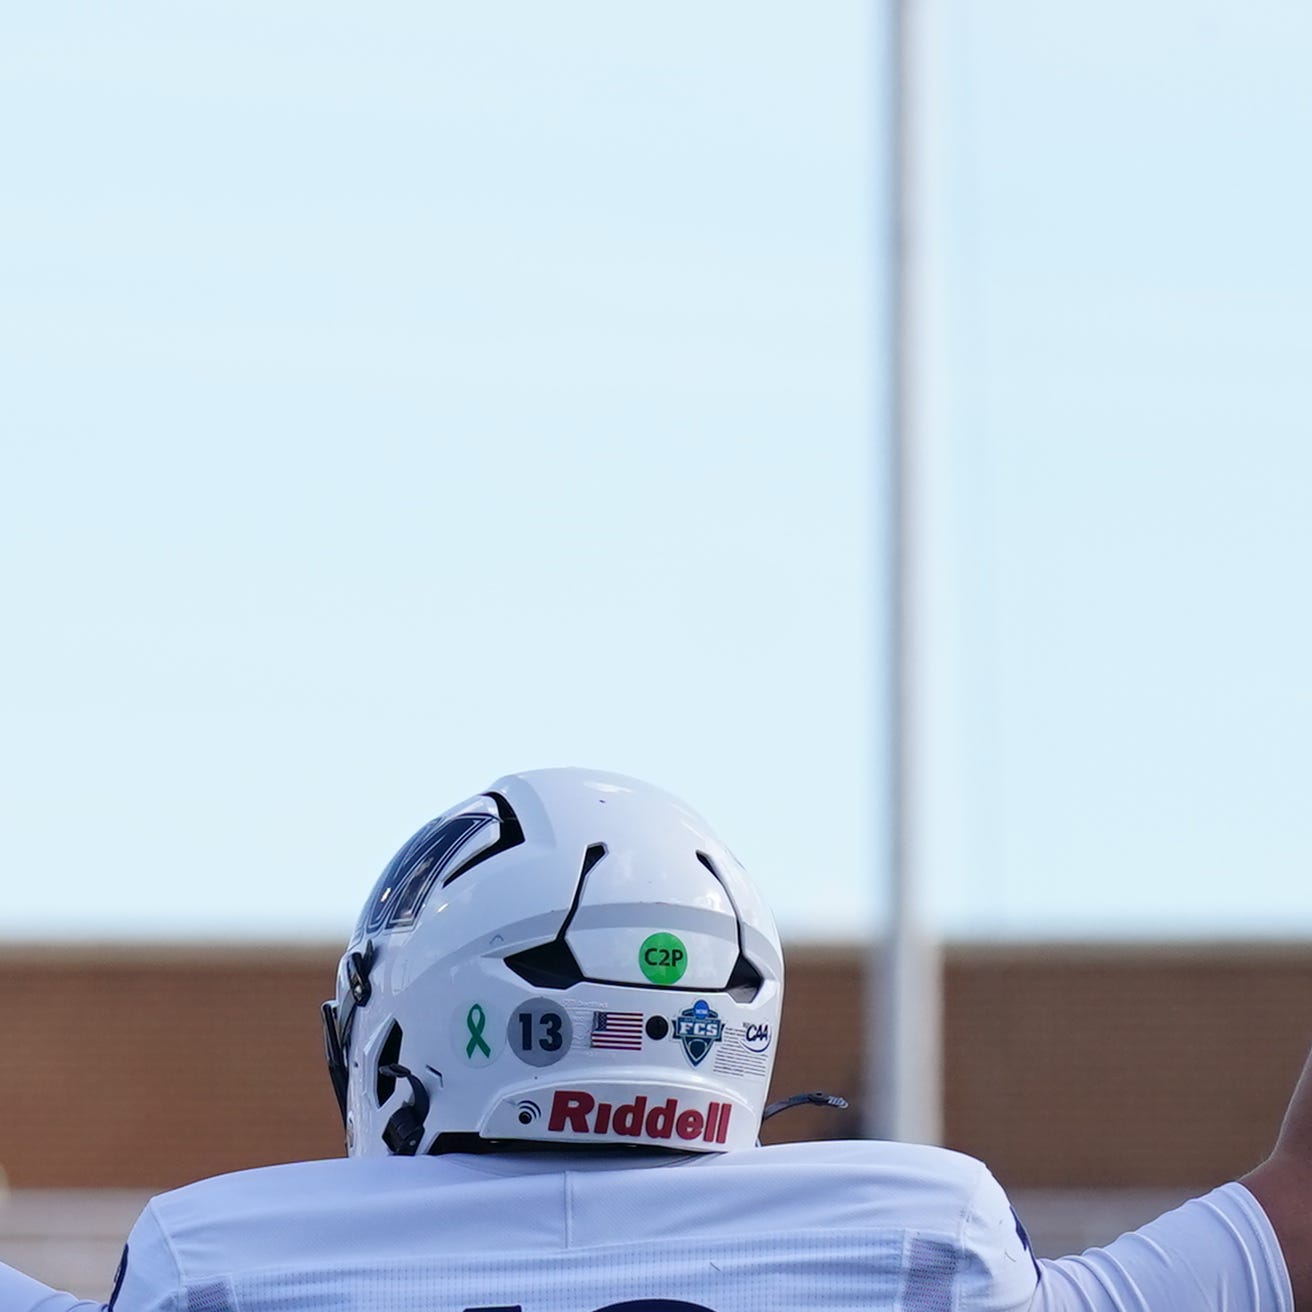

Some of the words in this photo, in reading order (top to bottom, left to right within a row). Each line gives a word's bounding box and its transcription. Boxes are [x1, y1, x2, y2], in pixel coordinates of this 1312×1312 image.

[644, 947, 684, 967] C2P
[518, 1013, 564, 1052] 13
[679, 1021, 719, 1037] FCS
[548, 1091, 733, 1144] Riddell
